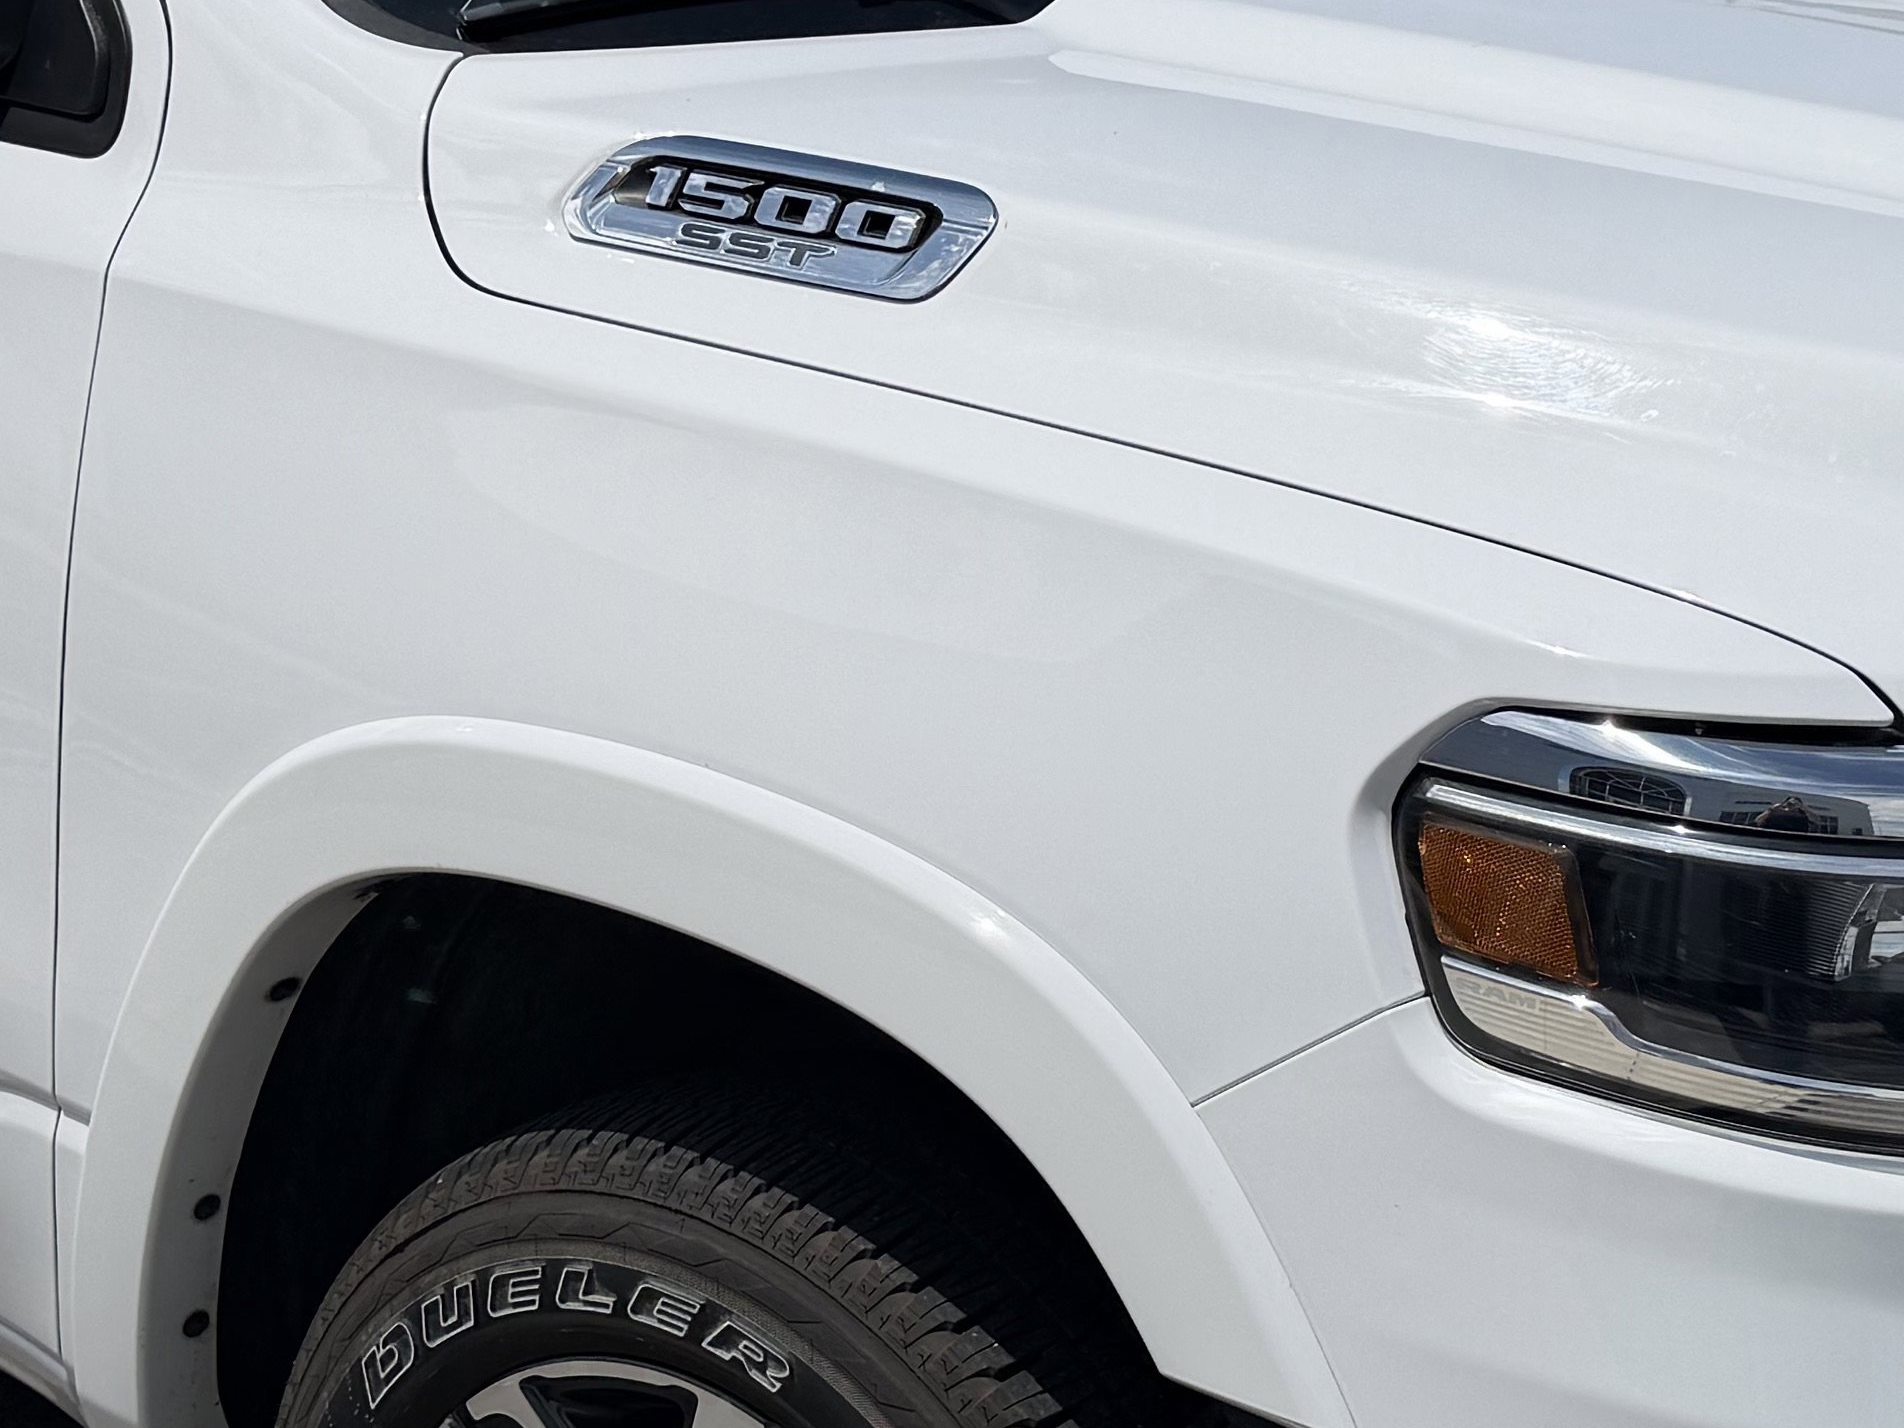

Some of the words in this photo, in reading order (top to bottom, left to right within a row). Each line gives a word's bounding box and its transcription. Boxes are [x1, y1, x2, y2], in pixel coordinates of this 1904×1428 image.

[642, 164, 927, 252] 1500
[673, 222, 835, 268] SST
[360, 1264, 792, 1410] DUELER
